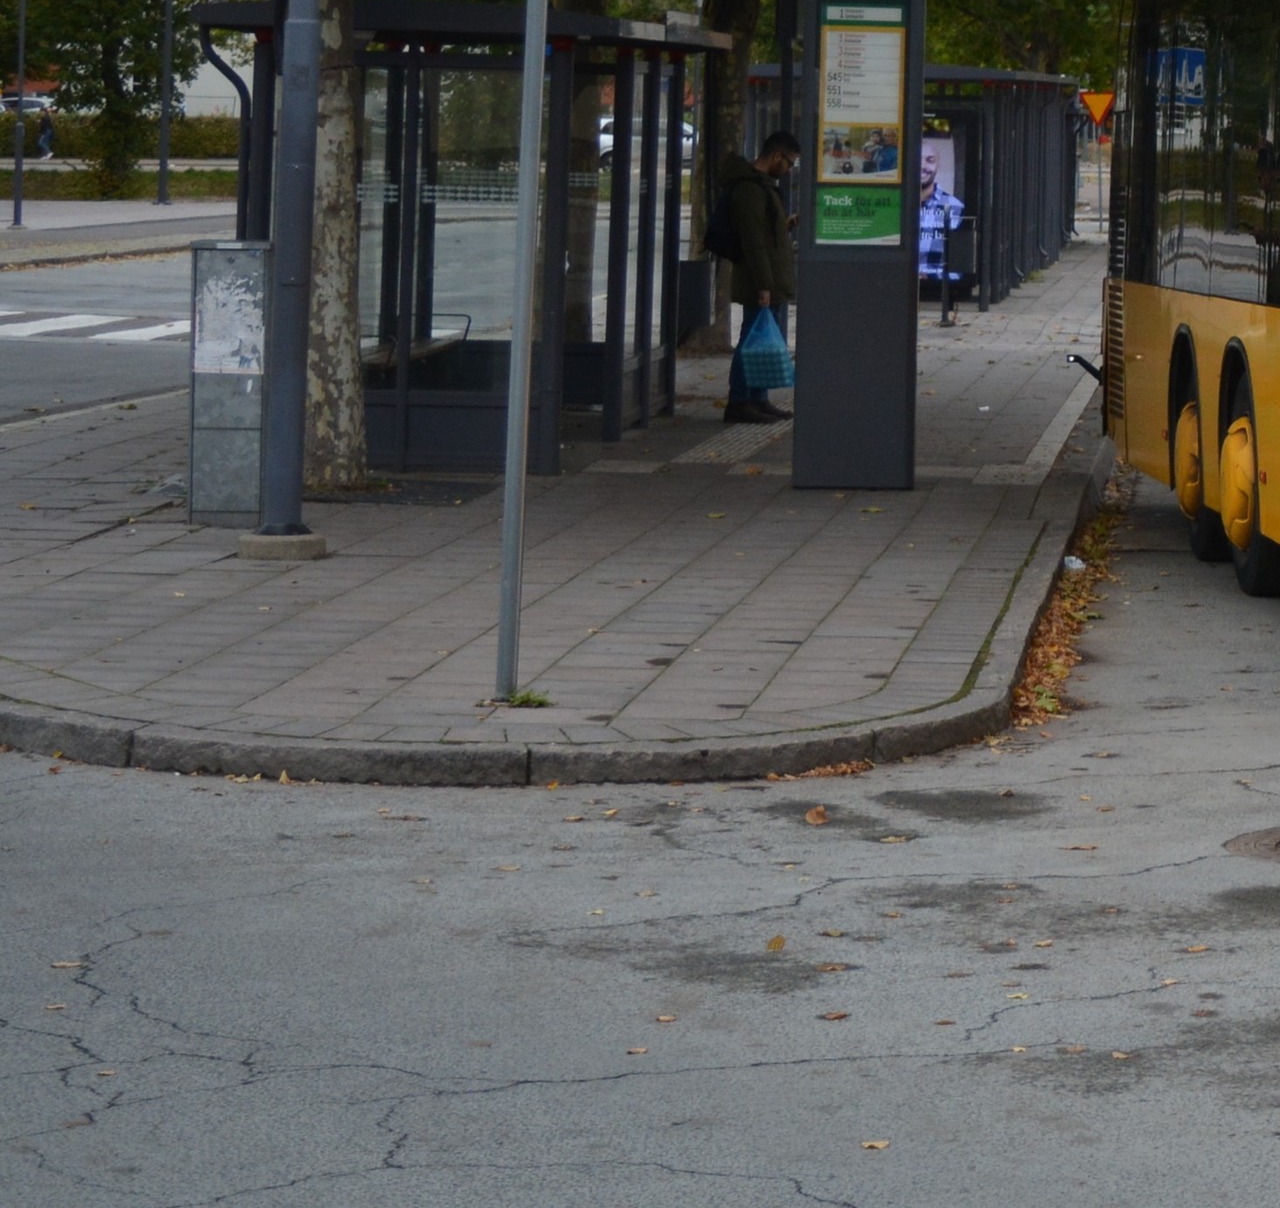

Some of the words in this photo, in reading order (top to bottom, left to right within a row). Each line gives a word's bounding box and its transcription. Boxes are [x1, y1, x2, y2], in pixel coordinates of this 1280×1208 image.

[827, 72, 843, 82] 545
[827, 85, 841, 95] 551
[824, 195, 852, 206] Tack
